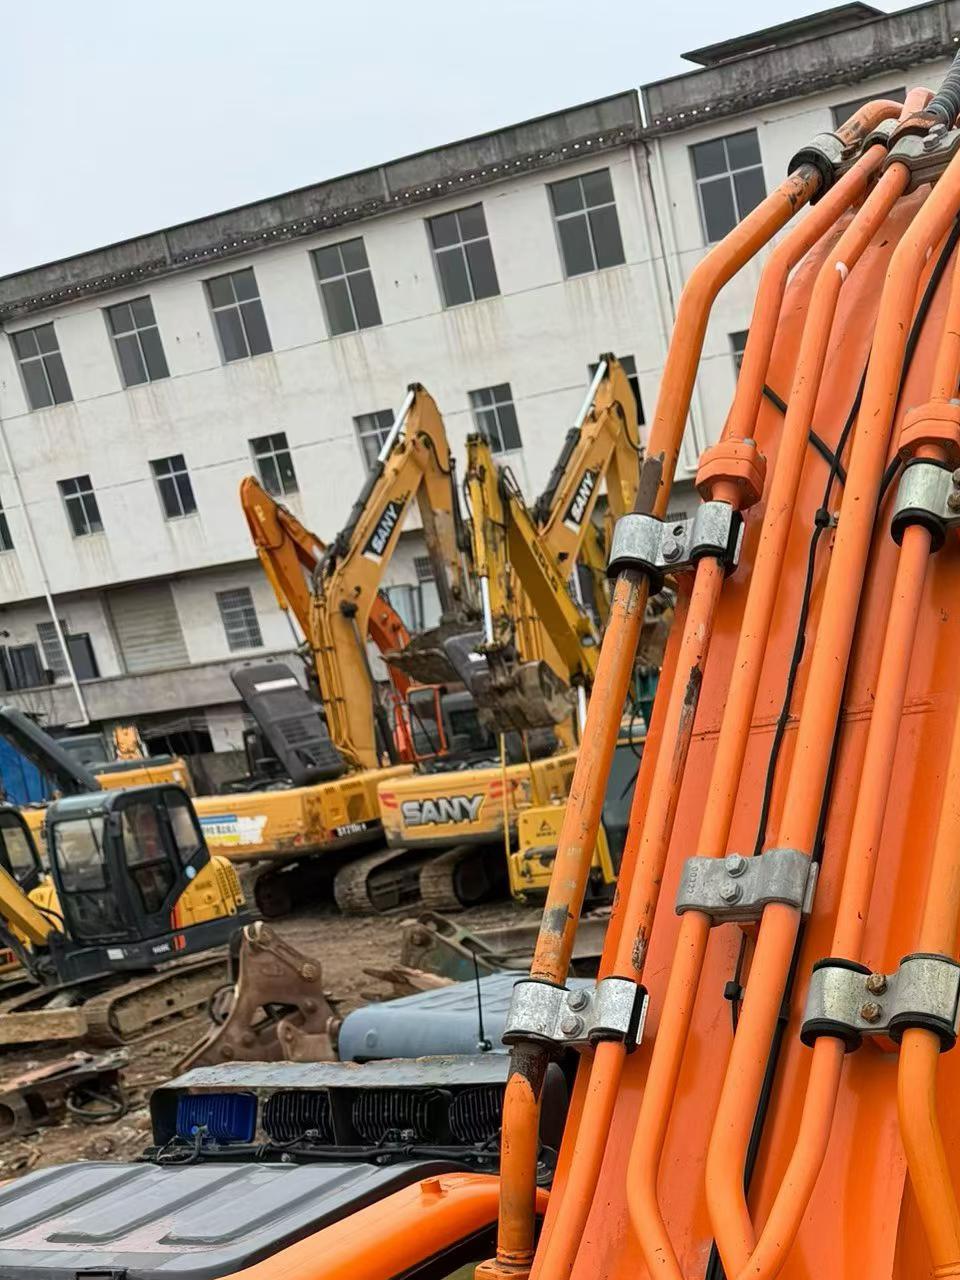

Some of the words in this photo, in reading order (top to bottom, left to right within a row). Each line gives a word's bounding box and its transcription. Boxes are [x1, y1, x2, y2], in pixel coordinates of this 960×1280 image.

[570, 470, 594, 523] SANY
[371, 503, 399, 555] SANY
[401, 794, 487, 828] SANY
